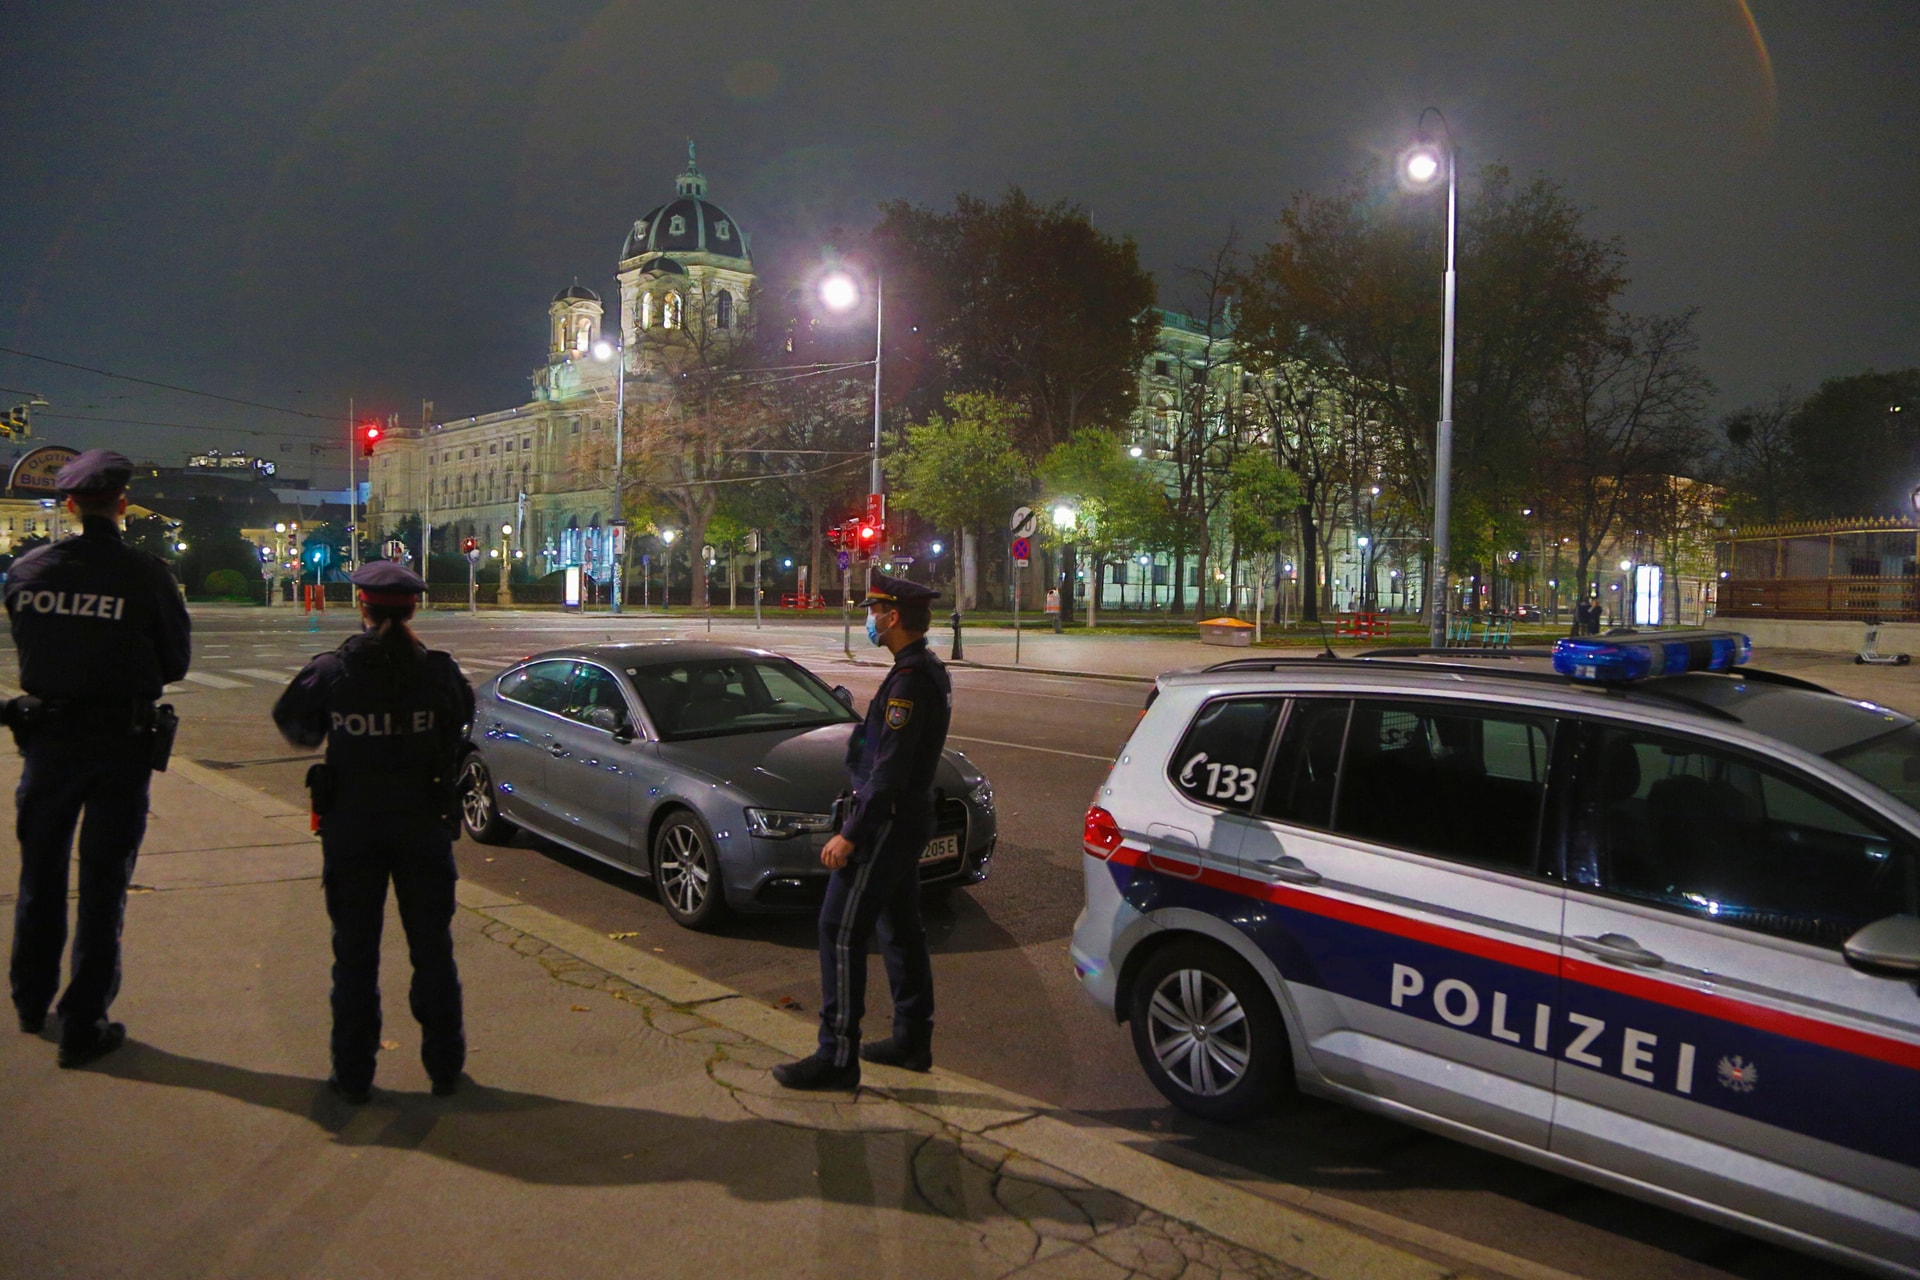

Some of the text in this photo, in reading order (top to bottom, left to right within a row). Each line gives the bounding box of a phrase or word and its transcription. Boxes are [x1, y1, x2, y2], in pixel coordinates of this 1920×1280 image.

[16, 590, 124, 620] POLIZEI
[331, 711, 434, 736] POLIEI
[1206, 763, 1257, 802] 133
[919, 840, 945, 858] 205
[1391, 962, 1696, 1094] POLIZEI
